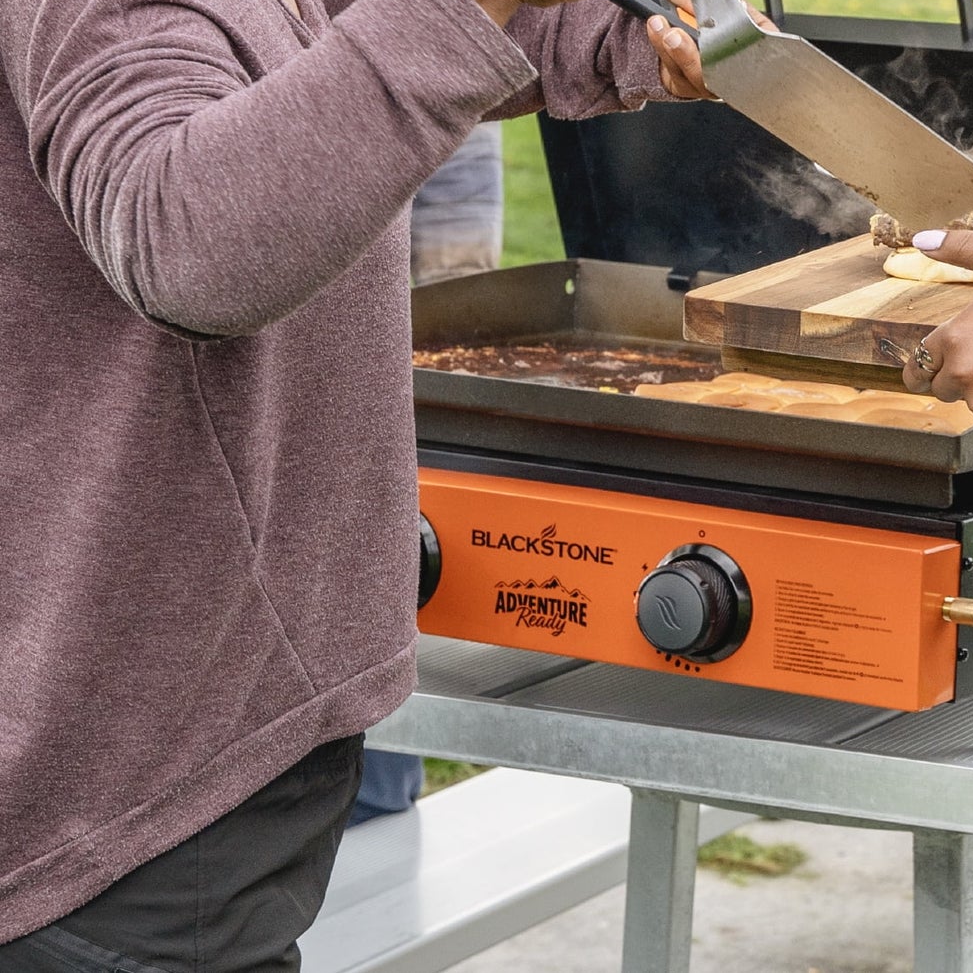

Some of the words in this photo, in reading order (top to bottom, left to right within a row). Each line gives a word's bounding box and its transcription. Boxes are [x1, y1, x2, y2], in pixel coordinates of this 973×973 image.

[471, 529, 614, 566] BLACKSTONE
[494, 589, 588, 627] ADVENTURE
[515, 605, 567, 636] Ready
